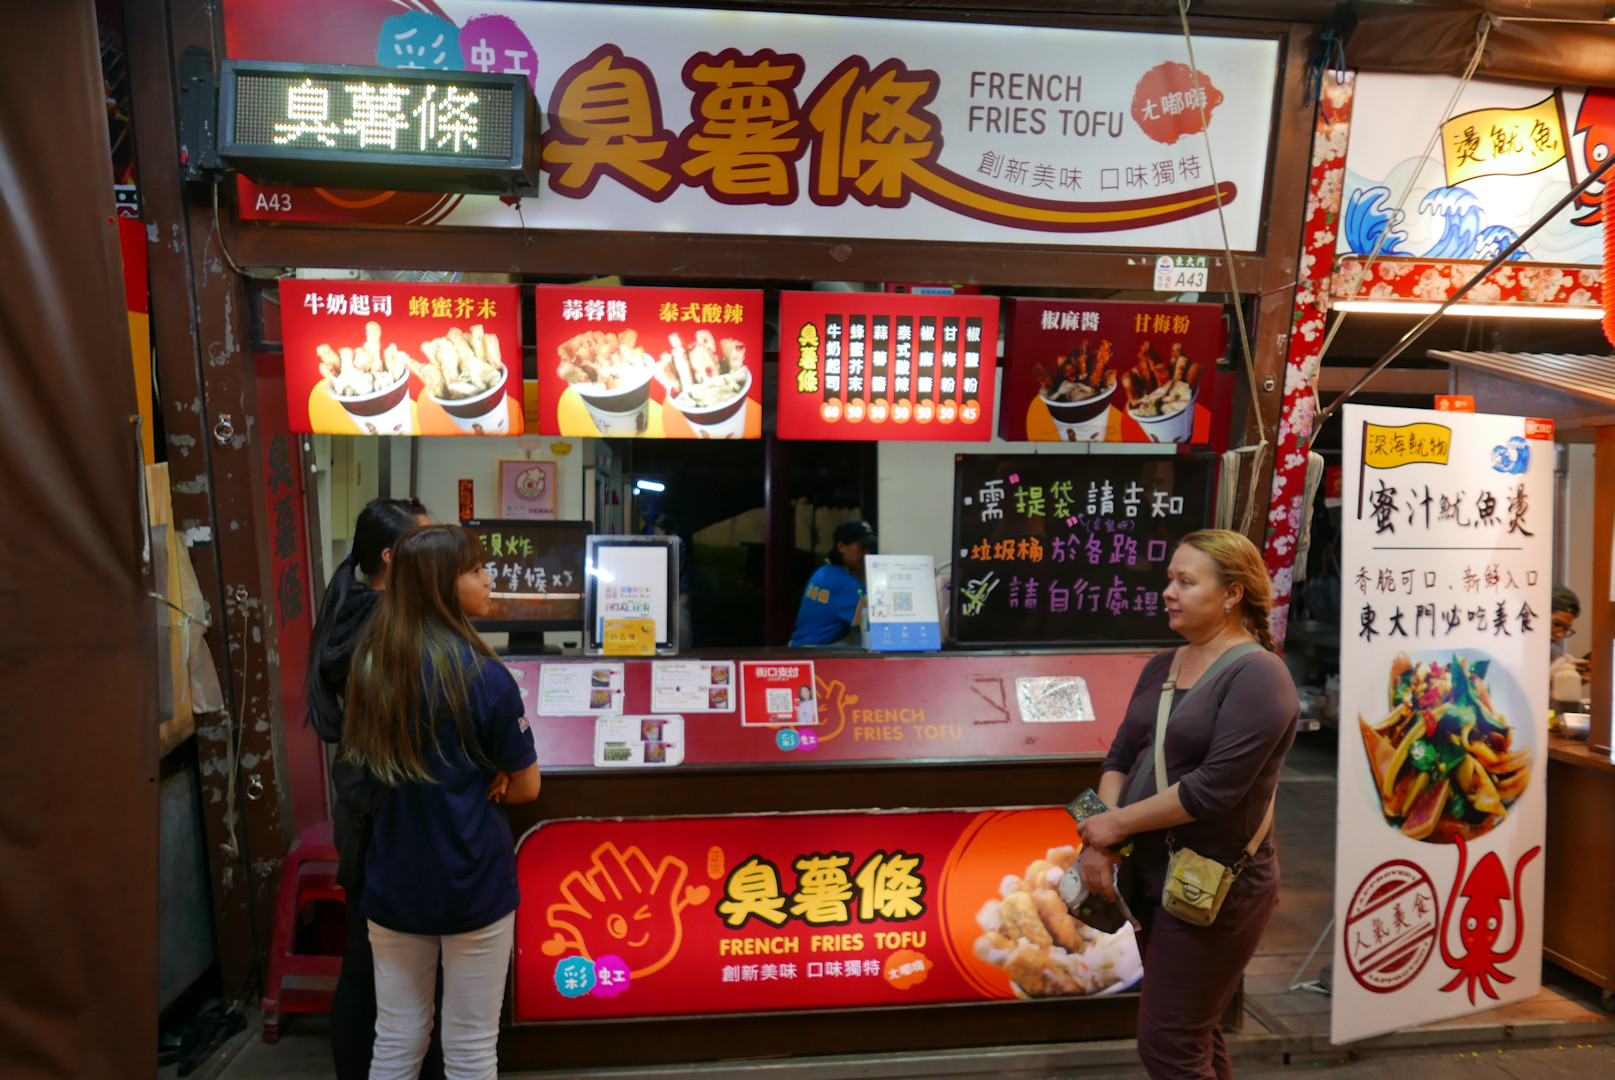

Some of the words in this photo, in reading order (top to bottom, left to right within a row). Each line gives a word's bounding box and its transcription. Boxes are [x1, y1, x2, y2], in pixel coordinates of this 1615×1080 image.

[970, 71, 1082, 102] FRENCH
[273, 78, 479, 152] 臭薯條
[541, 48, 938, 205] 臭薯條
[968, 105, 1047, 136] FRIES
[1059, 109, 1124, 138] TOFU
[1452, 118, 1558, 168] 燙魷魚
[977, 151, 1083, 191] 創新美味
[1100, 154, 1201, 191] 口味獨特
[255, 193, 292, 212] A43
[1174, 271, 1204, 287] A43
[303, 292, 394, 316] 牛奶起司
[408, 296, 498, 319] 蜂蜜芥末
[562, 298, 628, 322] 蒜蓉醬
[658, 301, 744, 324] 泰式酸辣
[1041, 310, 1100, 331] 椒麻醬
[1134, 313, 1191, 334] 甘梅粉
[796, 322, 819, 393] 臭薯條
[825, 323, 842, 392] 牛奶起司
[848, 323, 865, 392] 蜂蜜芥末
[894, 324, 912, 392] 泰式酸辣
[940, 326, 958, 394] 甘梅粉
[824, 406, 840, 418] 60
[847, 406, 863, 418] 50
[871, 406, 886, 418] 50
[894, 406, 910, 418] 50
[917, 406, 932, 418] 50
[940, 406, 955, 419] 50
[963, 407, 977, 419] 45
[1369, 432, 1448, 457] 深海魷物
[1369, 479, 1535, 537] 蜜汁魷魚燙
[268, 431, 303, 629] 臭薯條
[1009, 575, 1158, 616] 請自行處理
[1359, 599, 1539, 643] 東大門必吃美食
[755, 666, 800, 678] 街口支付
[852, 708, 925, 723] FRENCH
[854, 725, 903, 741] FRIES
[915, 724, 963, 740] TOFU
[717, 850, 925, 928] 臭薯條
[719, 936, 799, 956] FRENCH
[811, 933, 864, 953] FRIES
[874, 930, 927, 950] TOFU
[564, 965, 626, 991] 彩虹
[721, 963, 798, 982] 創新美味
[807, 959, 881, 979] 口味獨特
